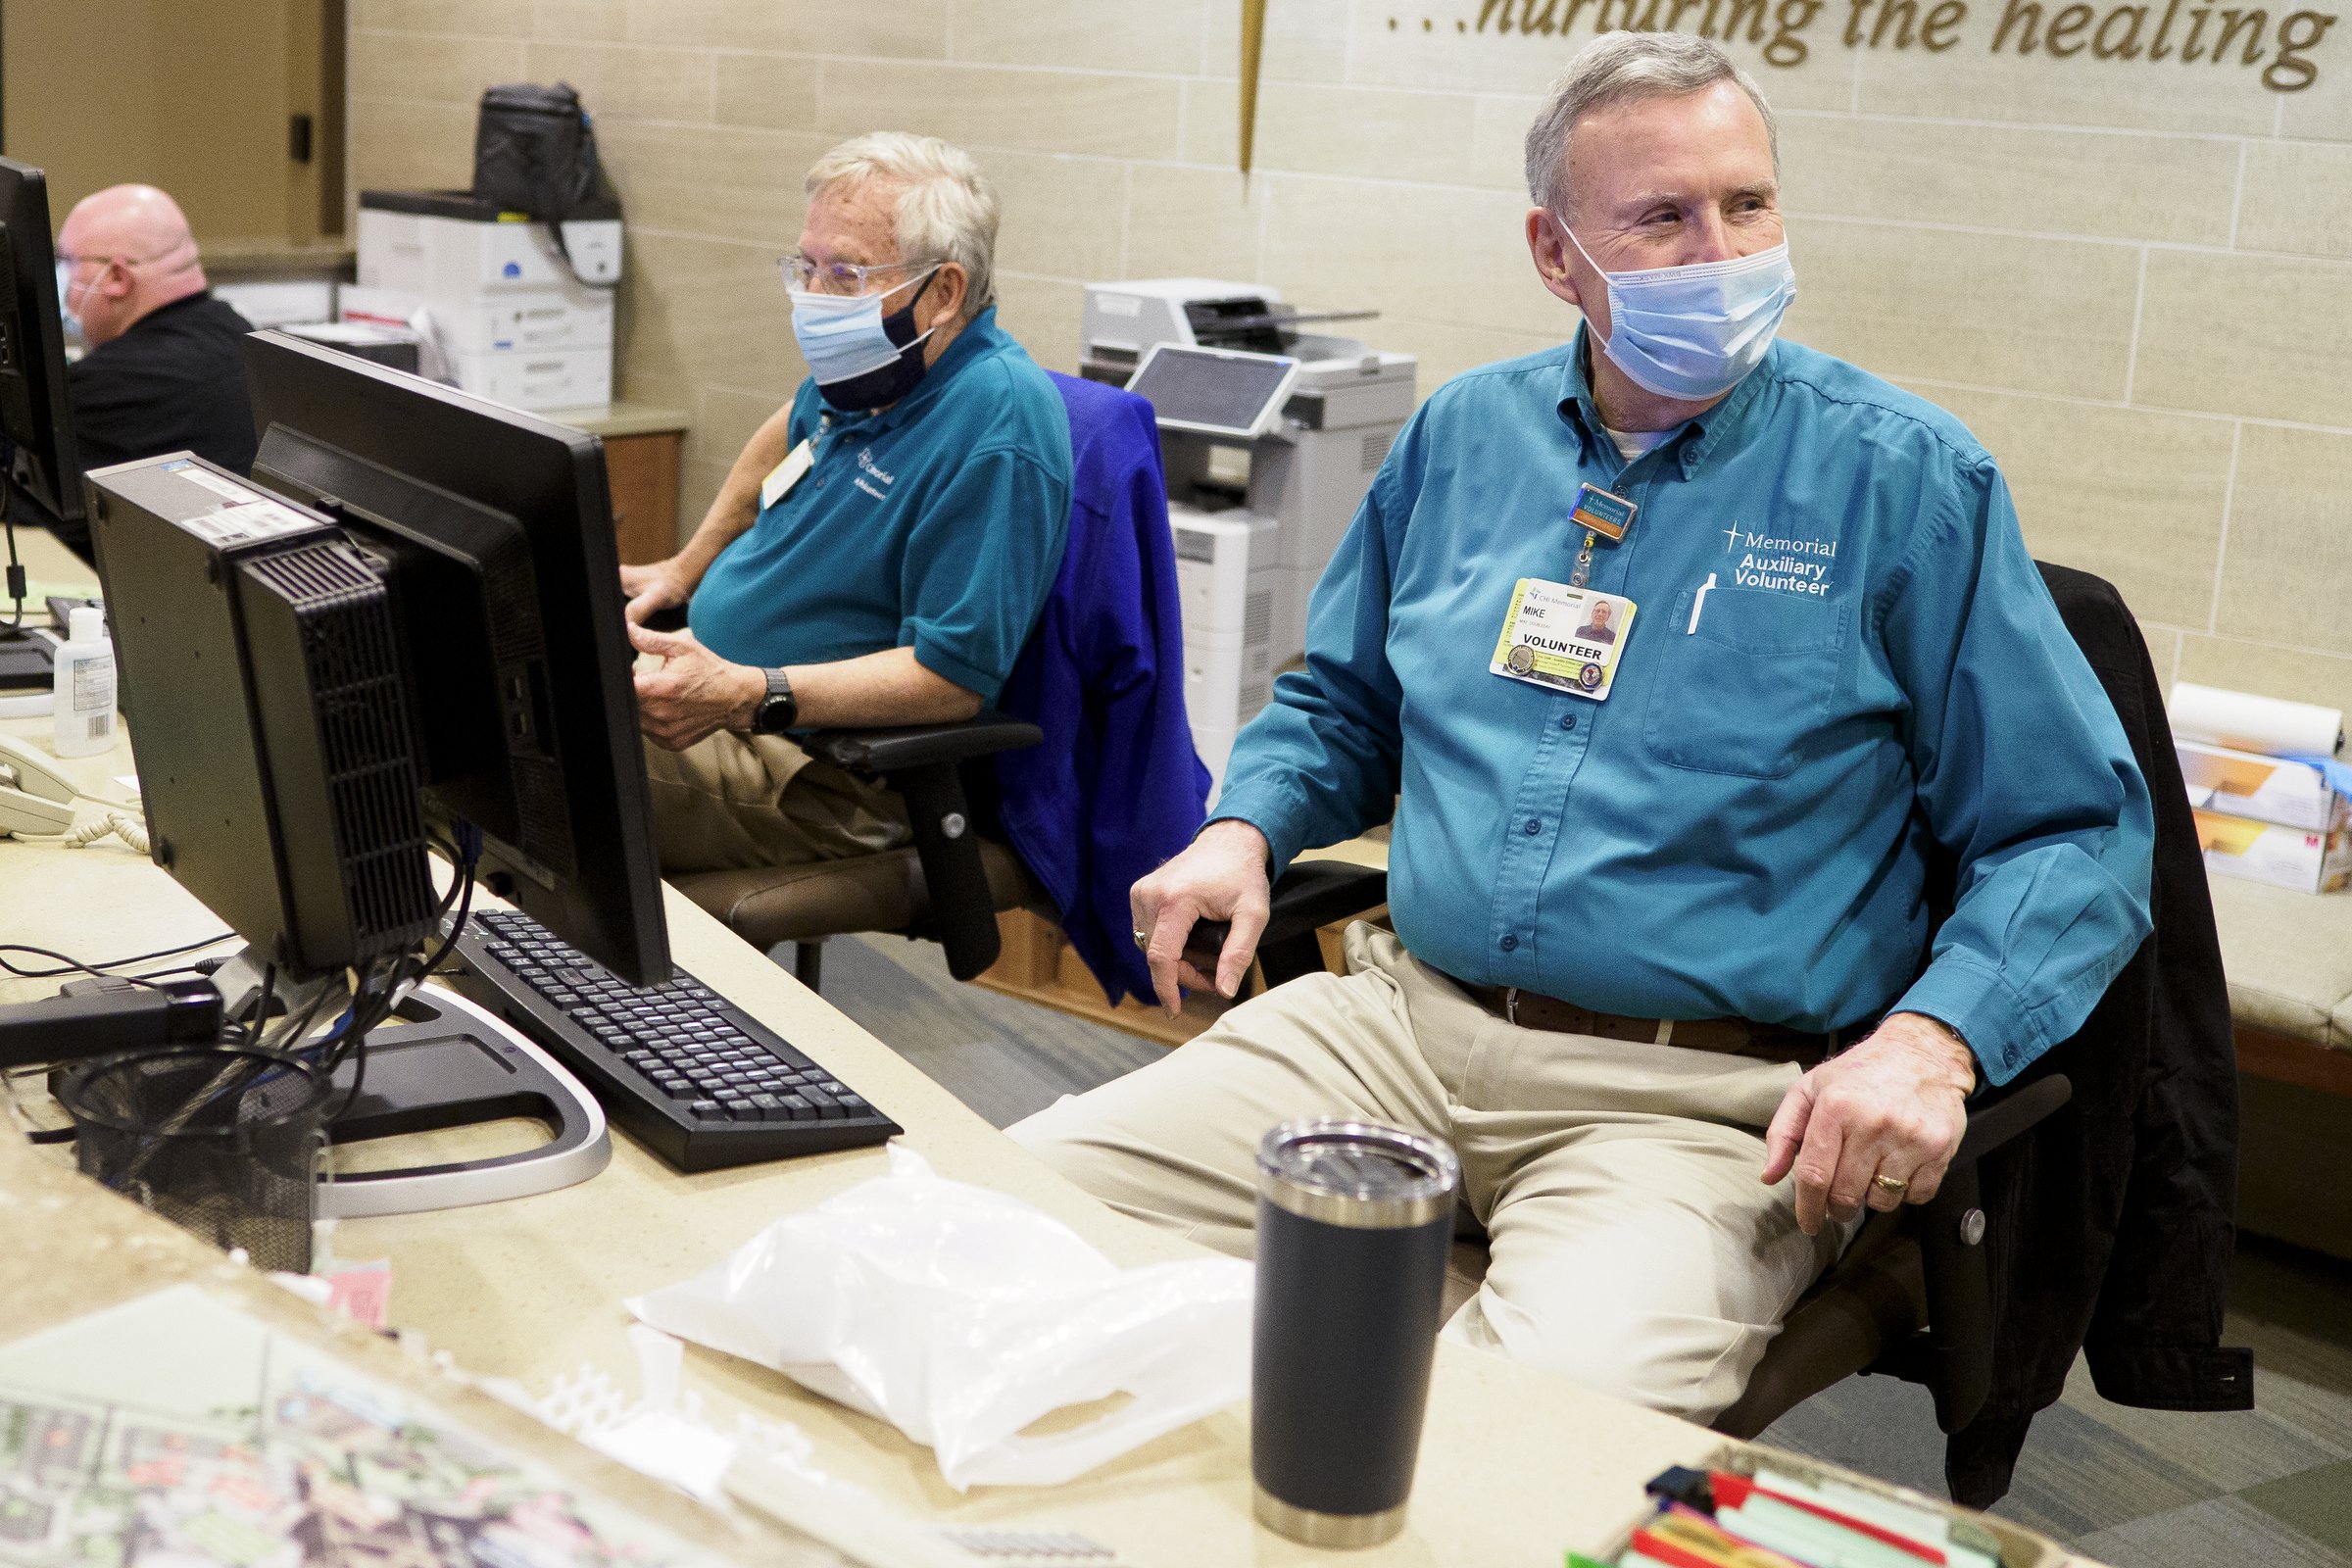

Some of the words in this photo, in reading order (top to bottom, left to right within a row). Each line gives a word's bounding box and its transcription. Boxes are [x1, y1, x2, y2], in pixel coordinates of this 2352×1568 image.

[1990, 0, 2338, 92] healing
[1583, 505, 1622, 525] VOLUNTEERS
[1593, 499, 1626, 516] Memorial
[1745, 532, 1837, 558] Memorial
[1740, 553, 1827, 581] Auxiliary
[1735, 568, 1832, 597] Volunteer
[1522, 605, 1546, 618] MIKE
[1551, 597, 1582, 610] Memorial
[1523, 633, 1602, 661] VOLUNTEER
